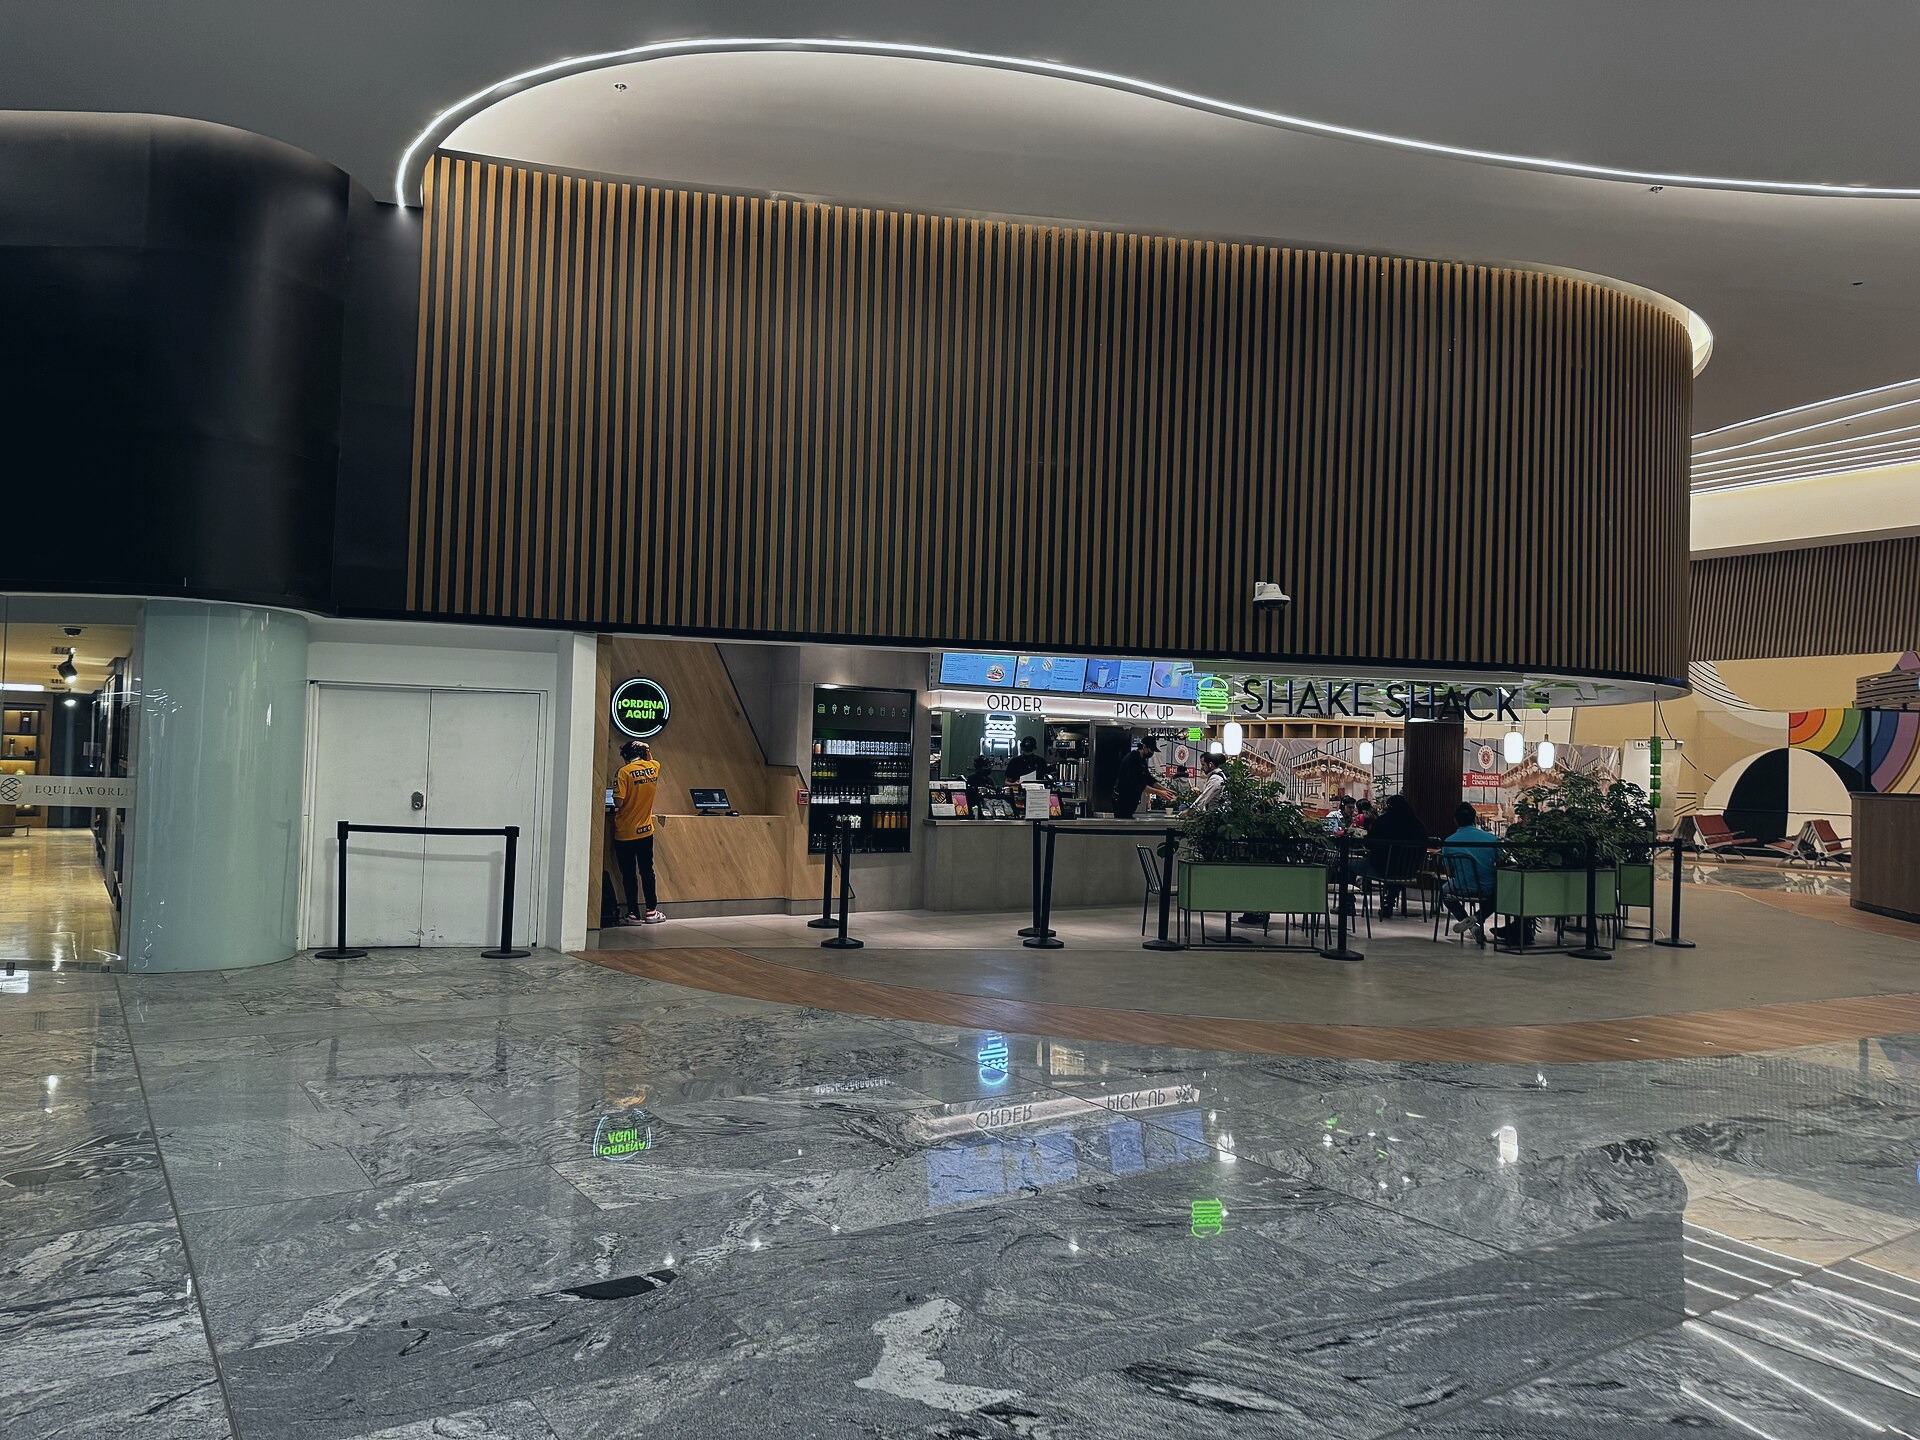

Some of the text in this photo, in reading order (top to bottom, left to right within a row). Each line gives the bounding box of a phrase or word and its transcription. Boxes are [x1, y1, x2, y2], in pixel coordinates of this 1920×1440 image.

[618, 698, 664, 710] ¡ORDENA
[986, 694, 1043, 712] ORDER
[1240, 678, 1375, 718] SHAKE
[1383, 683, 1522, 722] SHACK
[1116, 702, 1174, 720] PICK UP
